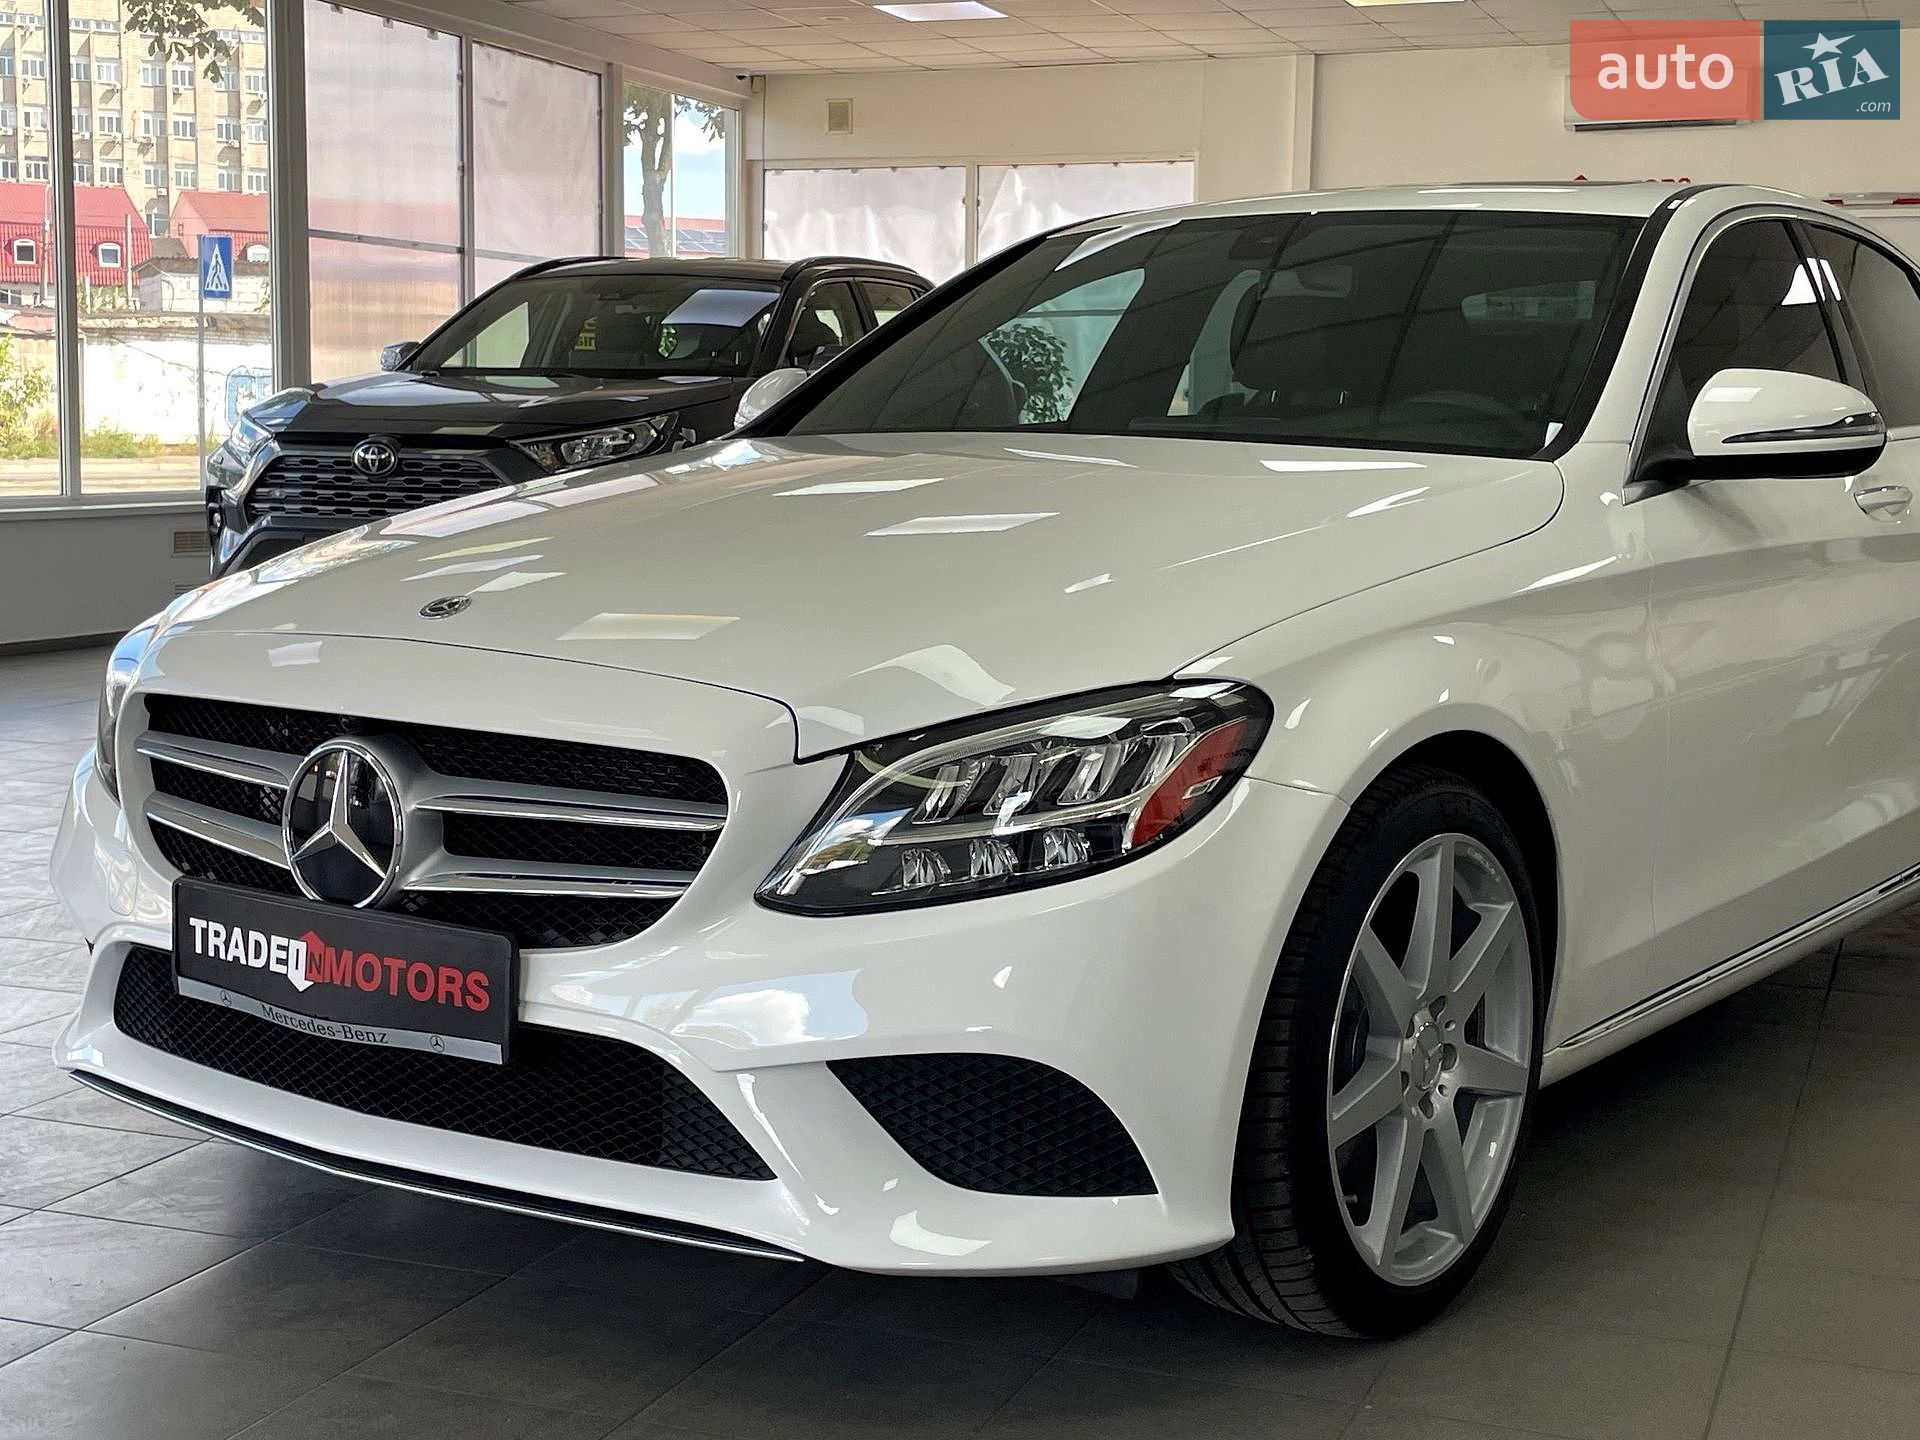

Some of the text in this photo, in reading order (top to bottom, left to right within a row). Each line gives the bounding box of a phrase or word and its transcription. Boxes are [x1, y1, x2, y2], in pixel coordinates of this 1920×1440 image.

[189, 916, 289, 975] TRADE
[324, 946, 490, 1012] MOTORS
[261, 1003, 389, 1044] Mercedes-Benz
